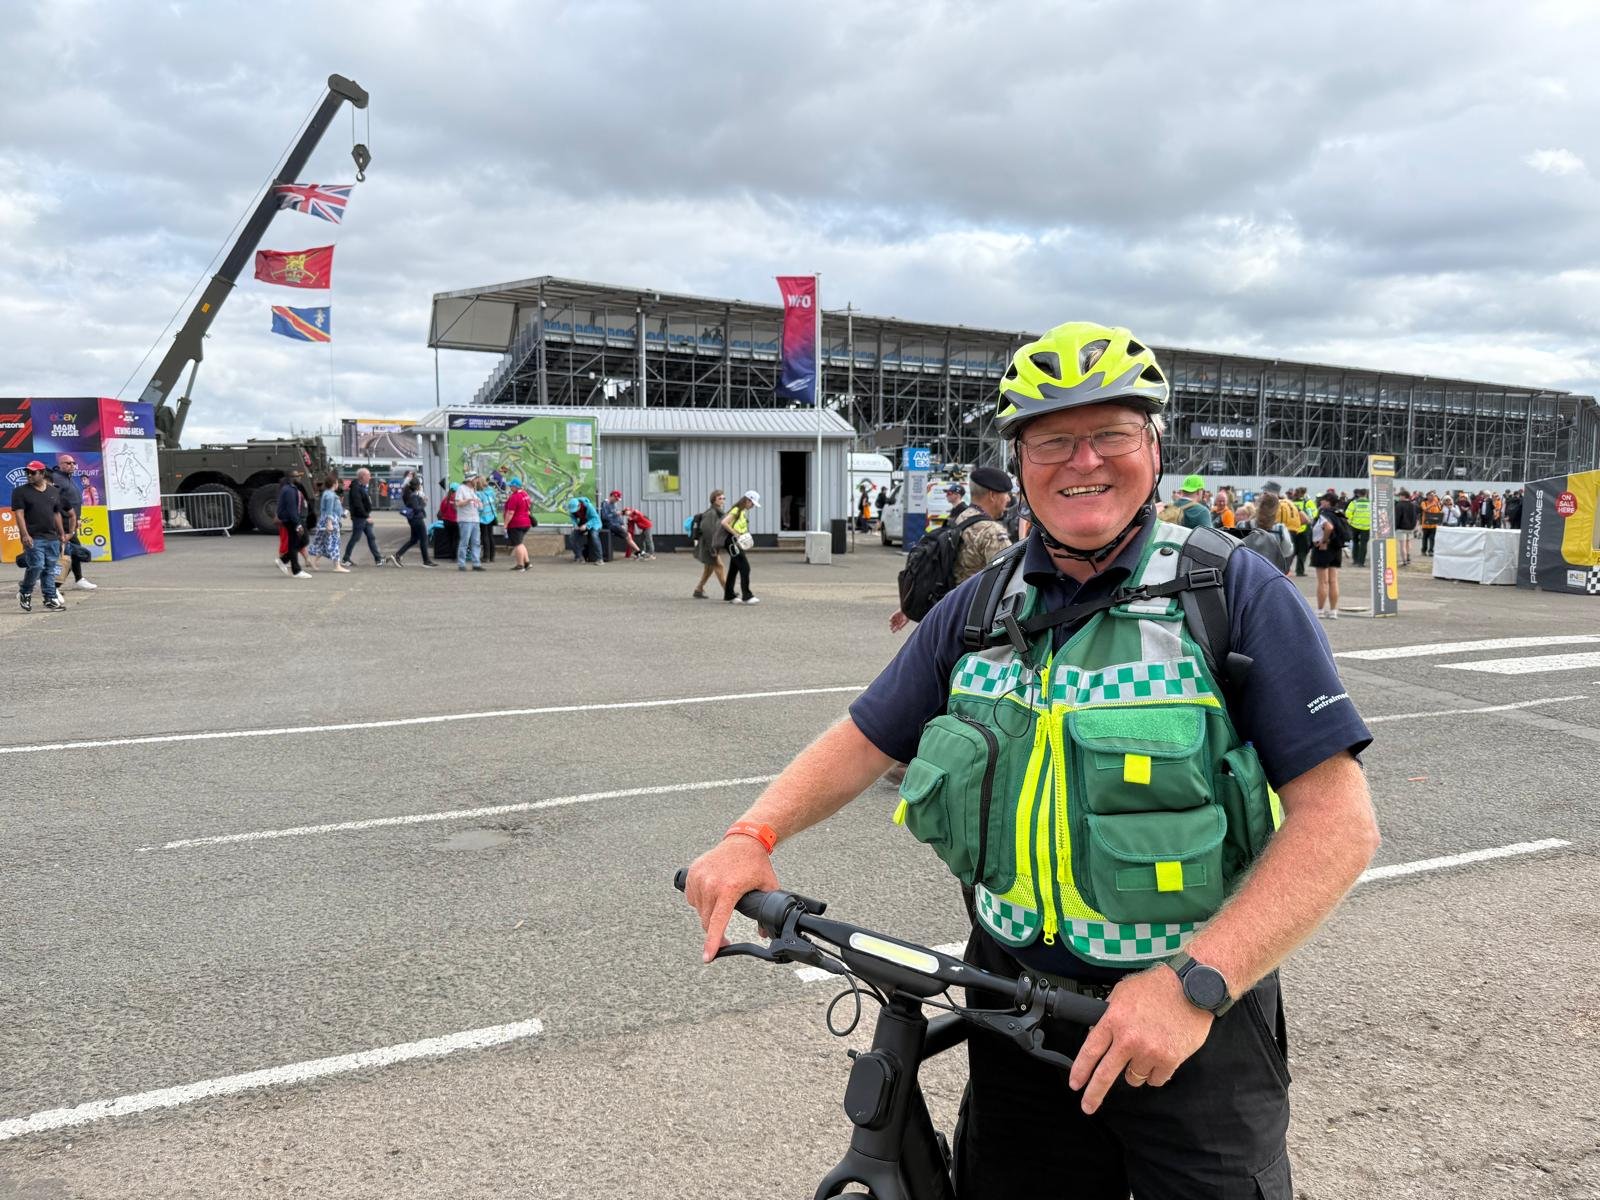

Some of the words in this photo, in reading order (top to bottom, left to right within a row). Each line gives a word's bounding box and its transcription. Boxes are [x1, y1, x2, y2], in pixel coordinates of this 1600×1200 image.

[49, 411, 77, 423] ebay
[72, 469, 100, 477] ECOURT
[1526, 511, 1535, 558] OFFICIAL
[1530, 489, 1544, 584] PROGRAMMES
[1306, 694, 1328, 709] www.
